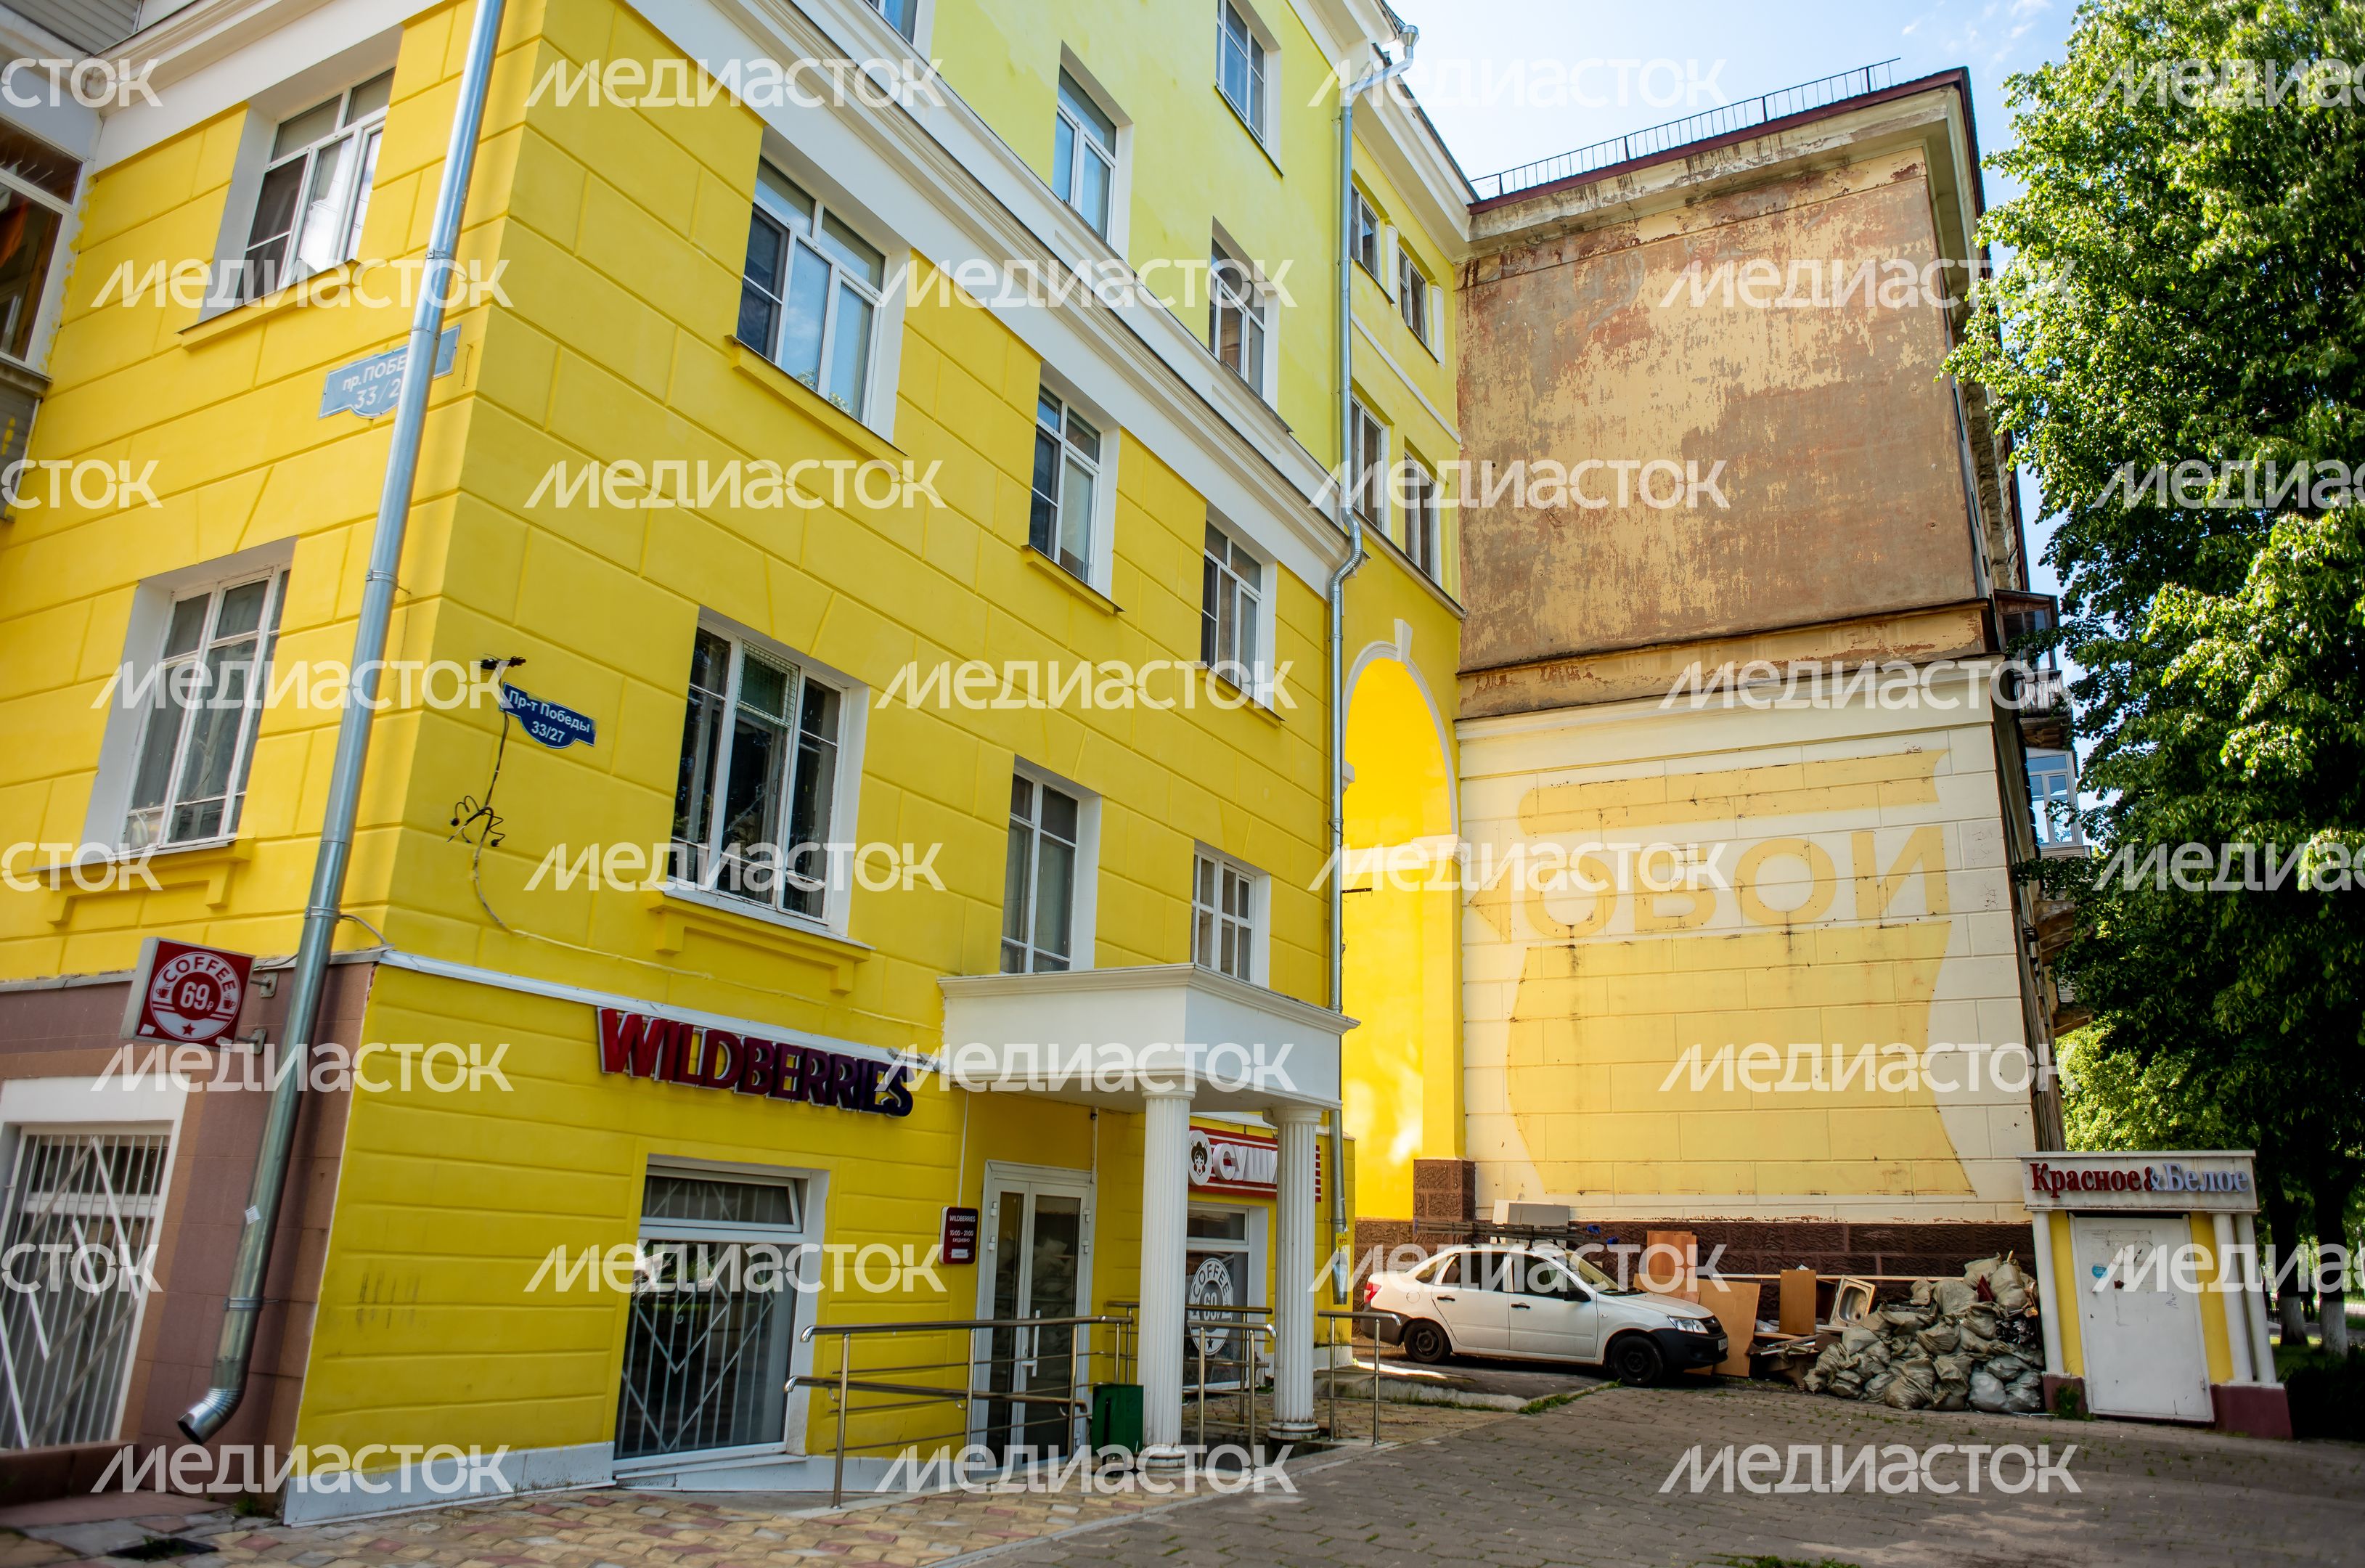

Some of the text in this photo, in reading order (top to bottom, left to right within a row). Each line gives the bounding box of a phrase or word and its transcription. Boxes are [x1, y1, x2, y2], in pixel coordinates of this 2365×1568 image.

[354, 377, 401, 409] 33/2
[509, 690, 590, 732] Пр-т Победы
[531, 720, 566, 743] 33/27
[163, 956, 237, 992] COFFEE
[598, 1007, 915, 1118] WILDBERRIES
[1193, 1262, 1230, 1299] COFFEE
